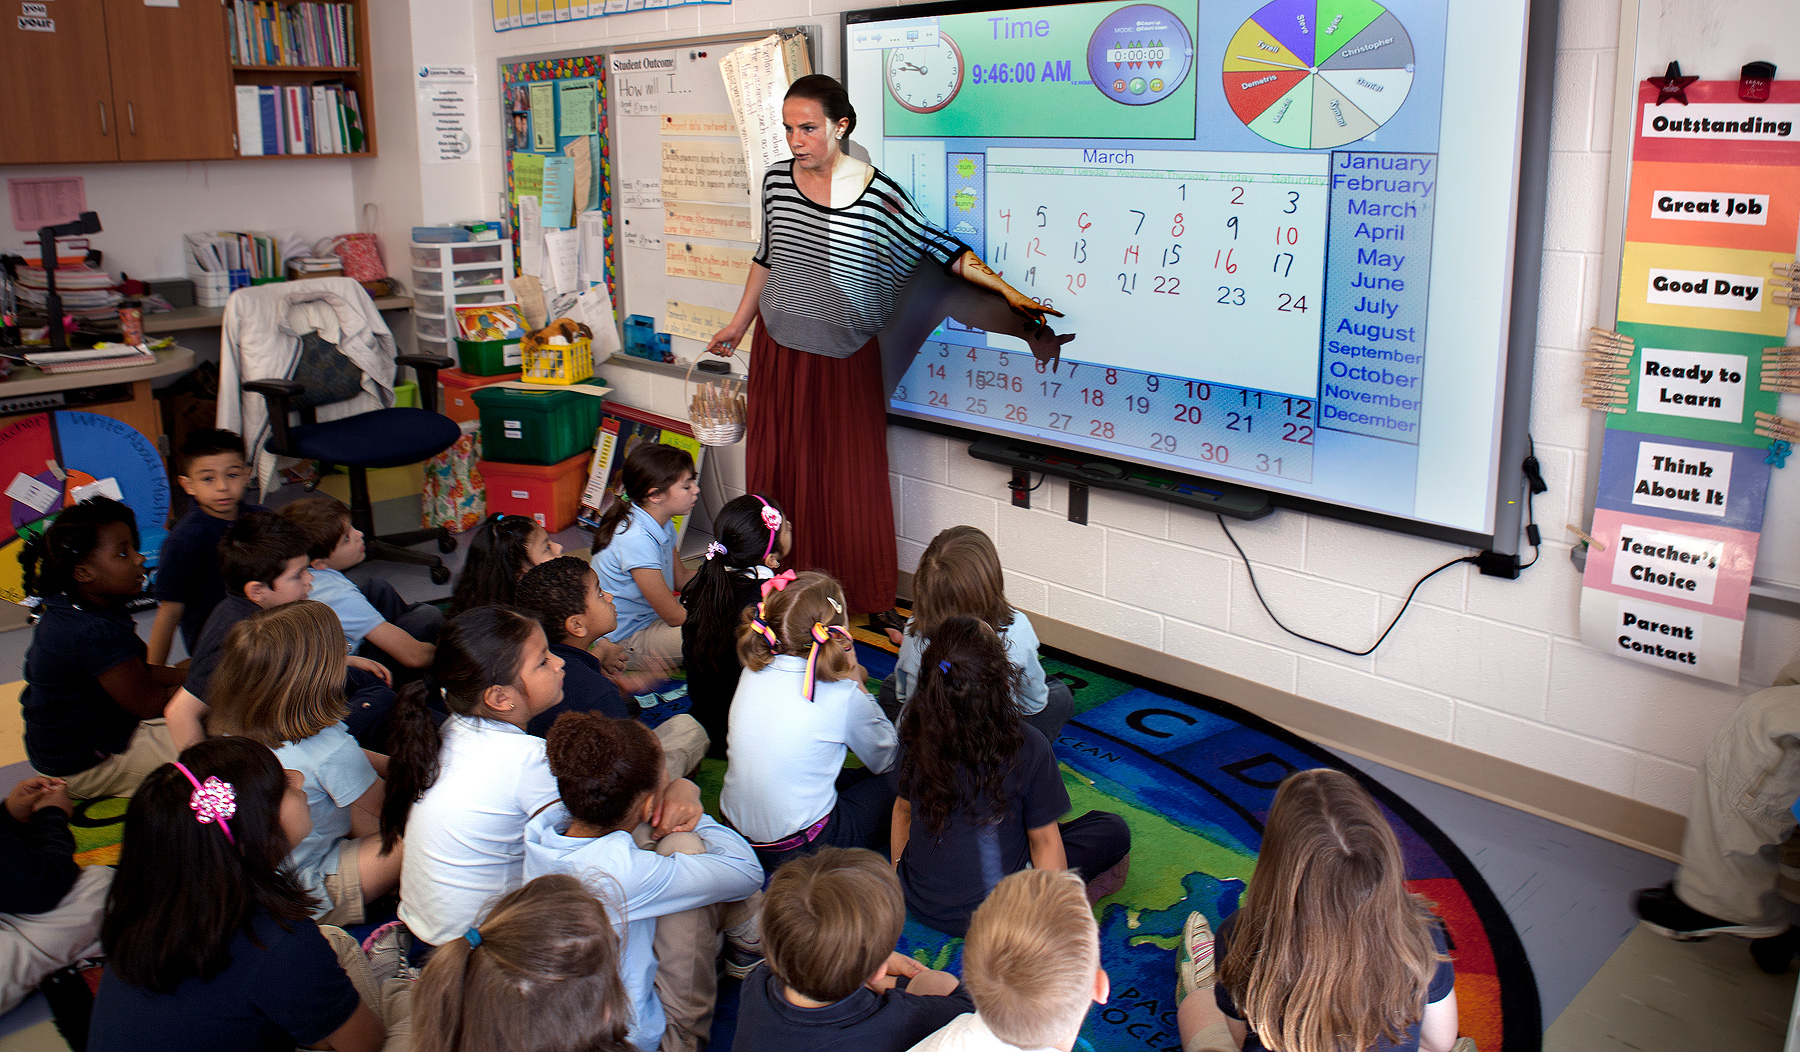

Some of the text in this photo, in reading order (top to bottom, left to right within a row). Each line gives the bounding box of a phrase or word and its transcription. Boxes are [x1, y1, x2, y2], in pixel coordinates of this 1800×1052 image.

[18, 18, 52, 28] your
[988, 17, 1050, 40] Time
[1296, 14, 1309, 35] Steve
[1325, 13, 1344, 36] Myles
[895, 53, 905, 62] 10
[947, 50, 953, 59] 2
[1115, 49, 1164, 61] 0:00:00
[1257, 40, 1280, 54] Tyrell
[1341, 36, 1394, 59] Christopher
[613, 58, 673, 71] Student Outcome
[891, 69, 897, 77] 9
[952, 66, 957, 75] 3
[973, 60, 1071, 84] 9:46:00 AM
[619, 78, 642, 97] How
[645, 77, 659, 95] will
[895, 83, 901, 91] 8
[948, 81, 953, 89] 4
[1241, 74, 1278, 90] Demetris
[1356, 77, 1384, 93] Daniel
[906, 94, 912, 103] 7
[922, 99, 928, 108] 6
[936, 94, 942, 102] 5
[1330, 99, 1347, 128] Kymani
[1652, 115, 1793, 136] Outstanding
[1083, 149, 1134, 164] March
[1340, 155, 1432, 176] January
[995, 165, 1327, 186] Sunday Monday Tuesday Wednesday Thursday Friday Saturday
[1332, 174, 1434, 197] February
[1178, 184, 1300, 214] 1 2 3
[1347, 199, 1417, 218] March
[1657, 197, 1763, 218] Great Job
[999, 205, 1298, 245] 4 5 6 7 8 9 10
[1354, 222, 1405, 242] April
[995, 237, 1294, 278] 11 12 13 14 15 16 17
[1357, 248, 1405, 271] May
[1025, 266, 1309, 314] 19 20 21 22 23 24
[1350, 272, 1405, 292] June
[1653, 276, 1708, 295] Good
[1714, 280, 1760, 301] Day
[1354, 297, 1399, 320] July
[1336, 318, 1416, 344] August
[1327, 341, 1422, 365] September
[938, 343, 1312, 420] 3 4 5 6 7 8 9 10 11 12
[1329, 361, 1419, 389] October
[1645, 361, 1742, 384] Ready to
[927, 363, 946, 380] 14
[1004, 375, 1023, 393] 16
[1040, 380, 1062, 399] 17
[1081, 387, 1104, 407] 18
[1125, 394, 1149, 414] 19
[1173, 403, 1202, 425] 20
[1226, 411, 1252, 433] 21
[1282, 422, 1314, 446] 22
[1325, 384, 1421, 412] November
[1659, 388, 1722, 409] Learn
[1323, 404, 1417, 434] December
[70, 412, 125, 434] Write
[124, 430, 162, 471] About
[928, 390, 949, 408] 24
[966, 396, 987, 415] 25
[1005, 403, 1028, 423] 26
[1049, 412, 1073, 431] 27
[1089, 419, 1115, 440] 28
[1150, 432, 1177, 453] 29
[1201, 442, 1229, 464] 30
[1256, 453, 1282, 475] 31
[1652, 455, 1714, 478] Think
[1634, 480, 1724, 506] About It
[1621, 536, 1717, 570] Teacher's
[1630, 565, 1697, 591] Choice
[1622, 612, 1694, 640] Parent
[1618, 635, 1697, 665] Contact
[1125, 708, 1198, 739] C
[1059, 734, 1122, 763] CEAN
[1219, 752, 1299, 790] D
[1117, 987, 1178, 1027] PAC
[1101, 1008, 1181, 1052] OCE
